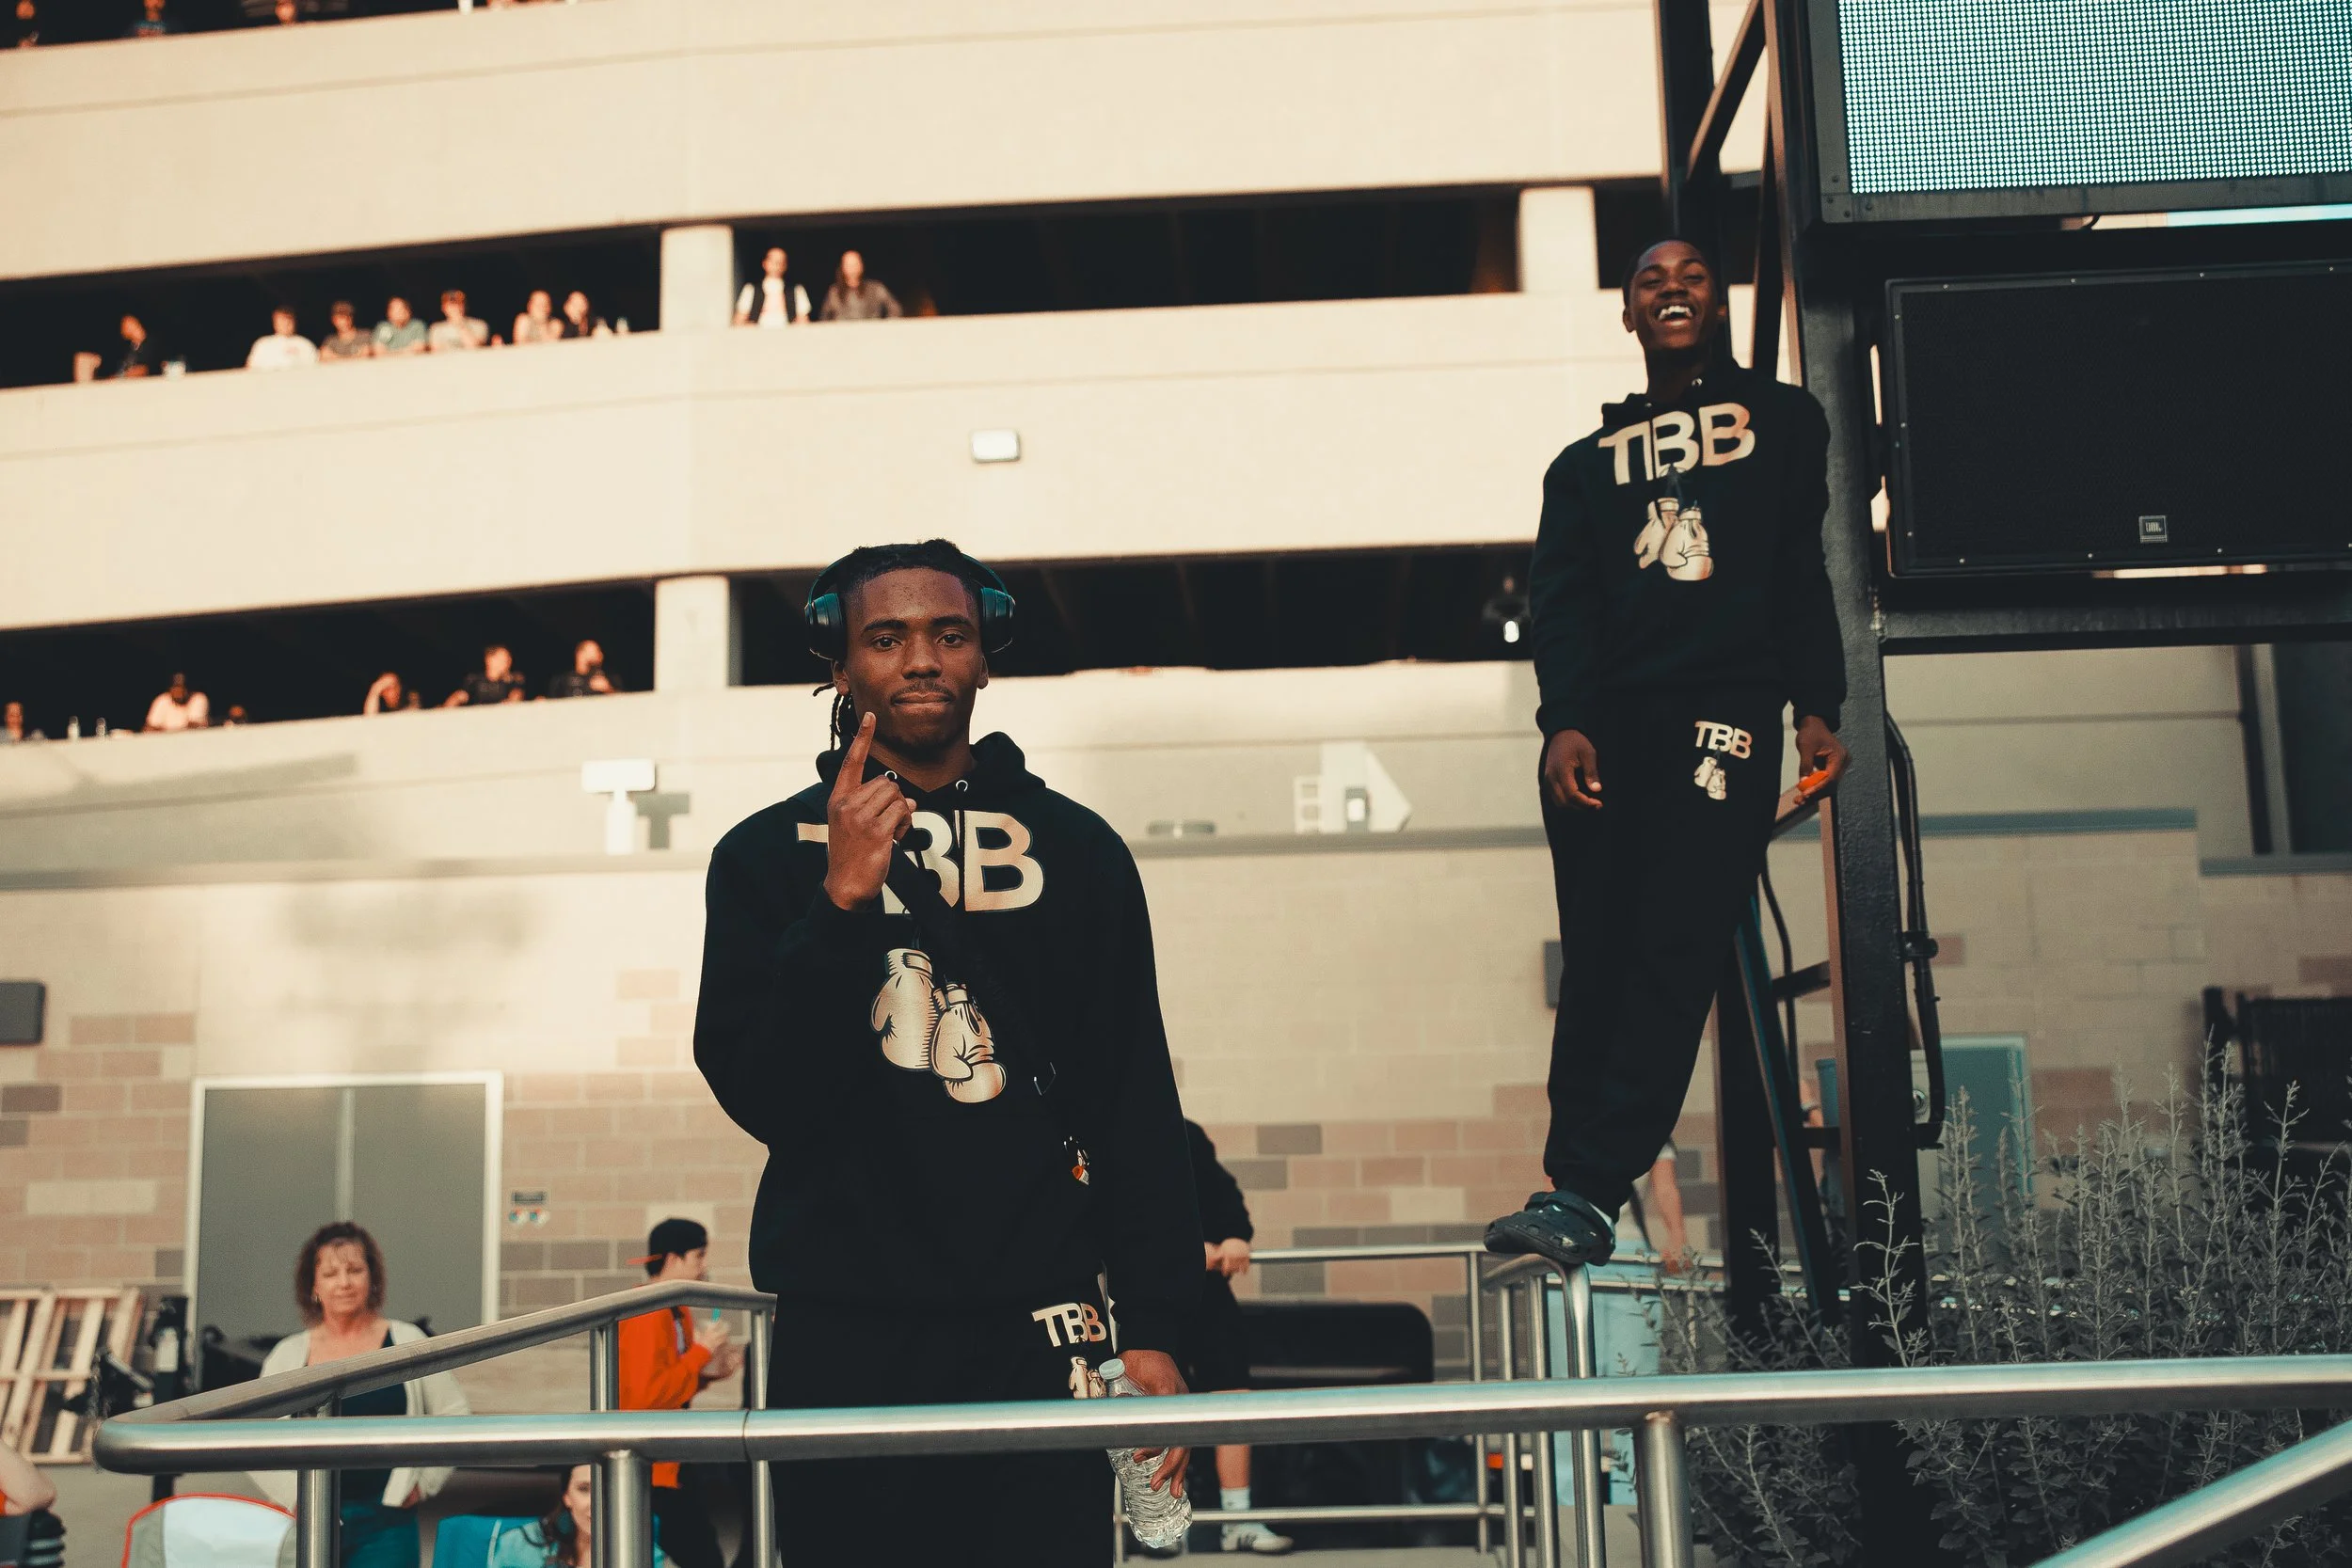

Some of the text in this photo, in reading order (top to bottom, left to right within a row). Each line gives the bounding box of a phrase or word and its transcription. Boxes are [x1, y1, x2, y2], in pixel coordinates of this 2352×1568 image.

[1597, 403, 1756, 485] TBB
[1694, 721, 1753, 759] TBB
[1031, 1303, 1107, 1347] TBB
